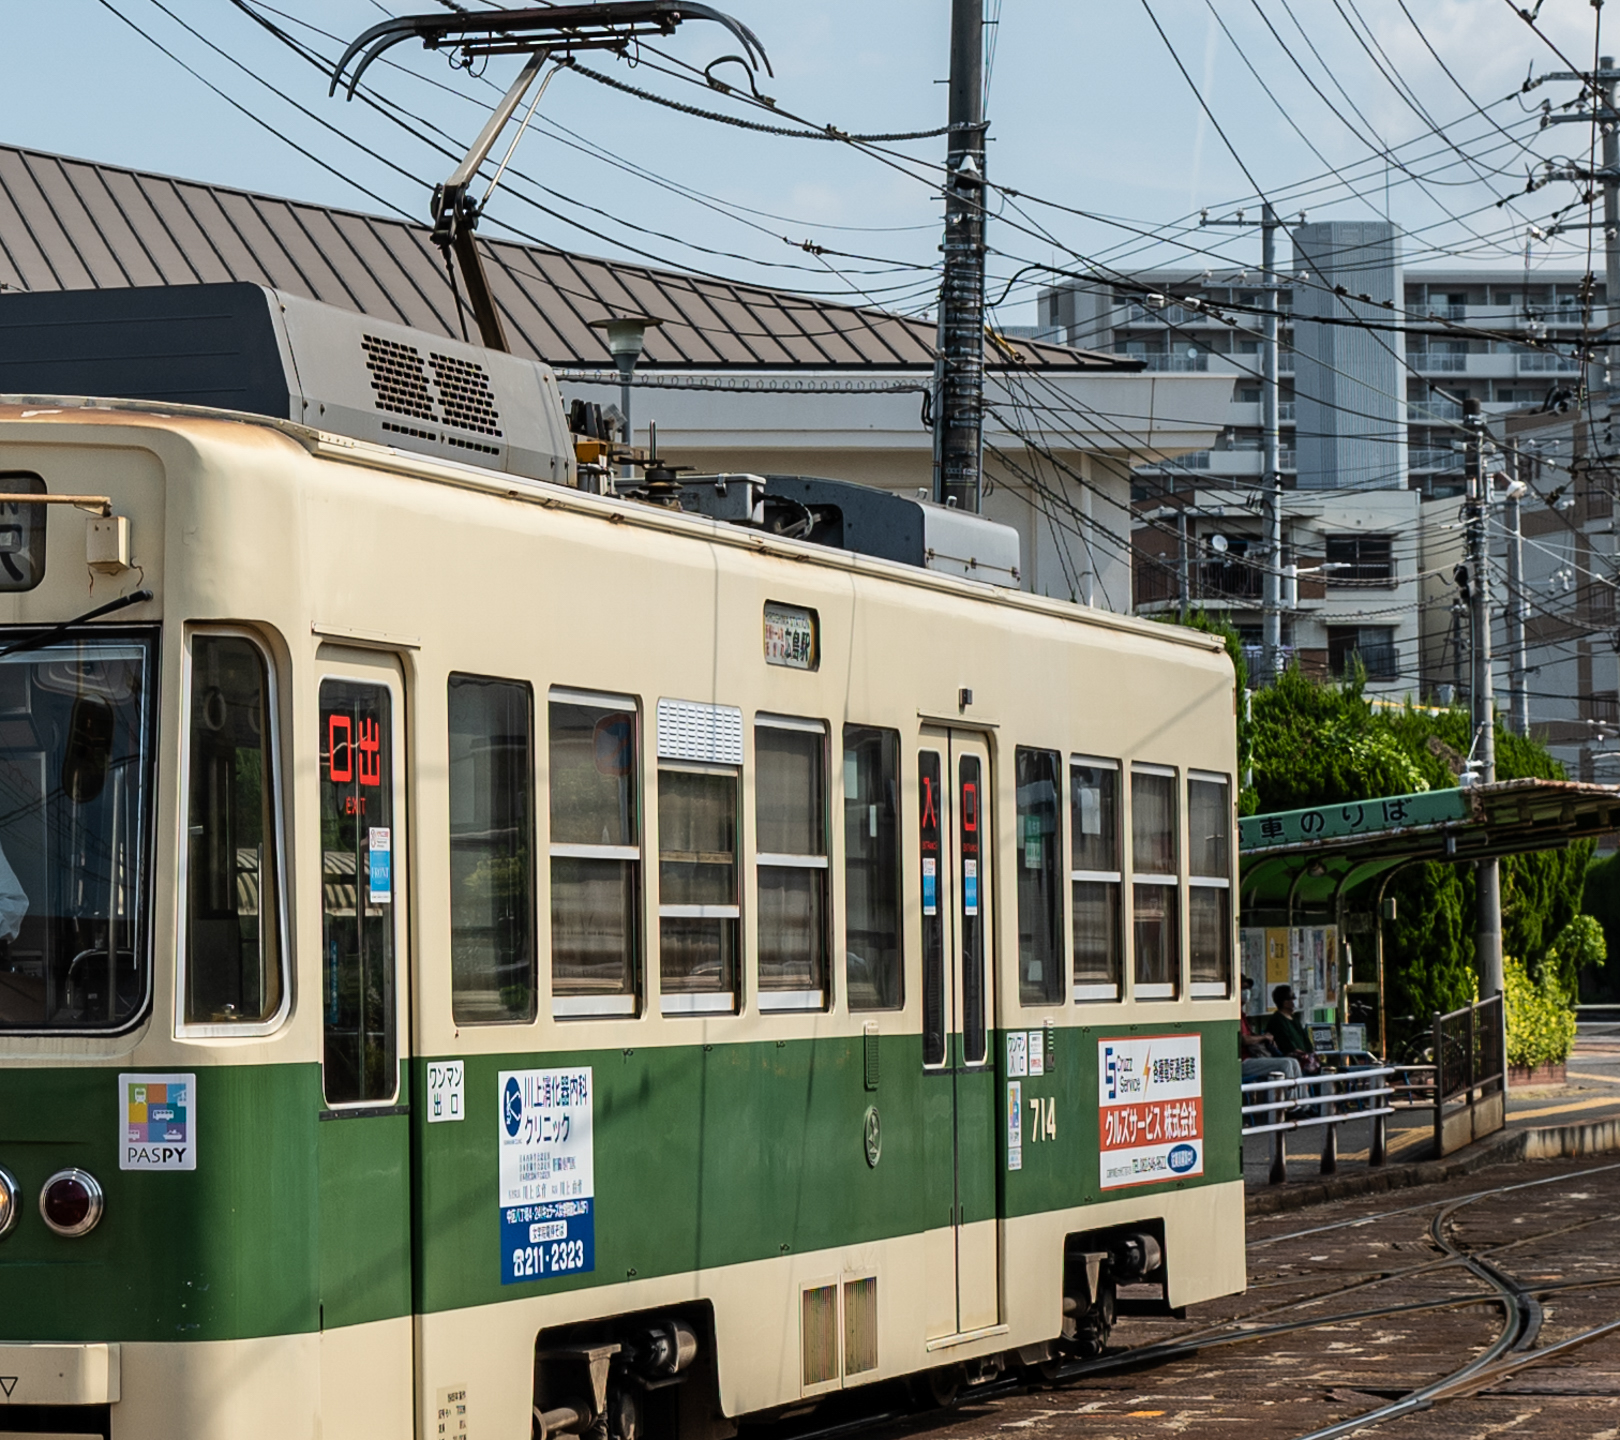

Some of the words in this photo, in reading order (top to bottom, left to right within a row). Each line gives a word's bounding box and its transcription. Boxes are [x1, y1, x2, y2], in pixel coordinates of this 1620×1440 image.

[1239, 797, 1413, 843] 車のりば
[1008, 1036, 1026, 1052] ワンマン
[429, 1066, 462, 1089] ワンマン
[524, 1073, 588, 1108] 川上消化器内科
[433, 1092, 459, 1116] 出口
[1029, 1096, 1057, 1143] 714
[524, 1112, 570, 1145] クリニック
[1105, 1105, 1162, 1147] クルズサービス
[1164, 1101, 1198, 1140] 株式会社
[127, 1147, 188, 1164] PASPY
